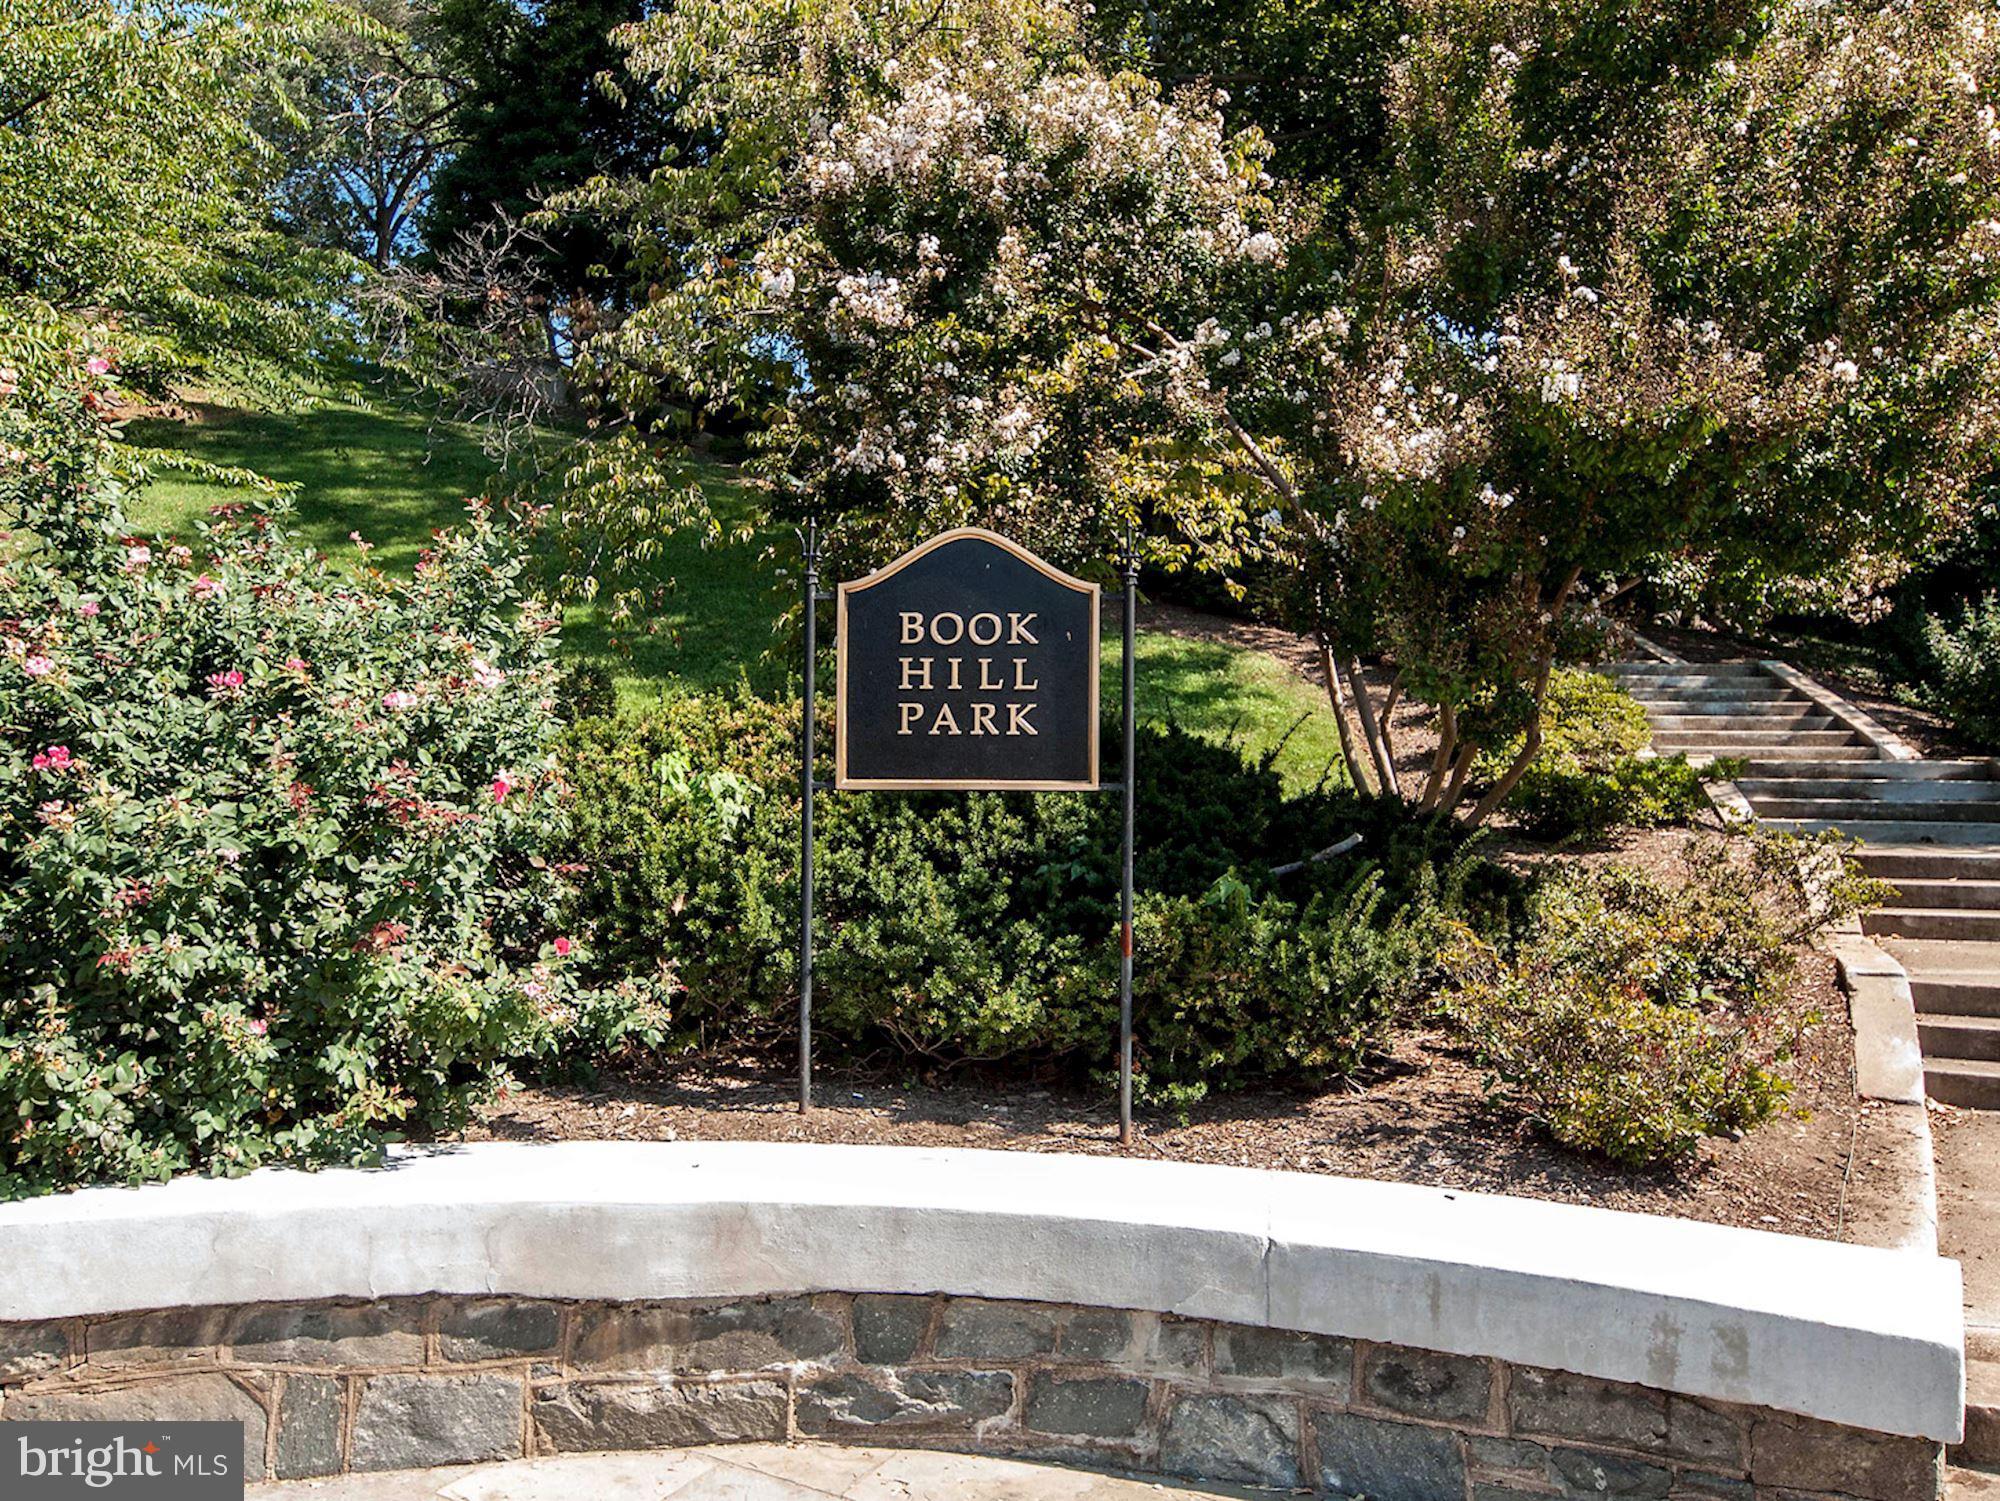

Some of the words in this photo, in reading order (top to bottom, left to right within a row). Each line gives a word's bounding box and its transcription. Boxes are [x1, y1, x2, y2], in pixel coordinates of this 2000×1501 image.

[898, 611, 1039, 646] BOOK
[897, 657, 1039, 691] HILL
[897, 702, 1039, 736] PARK
